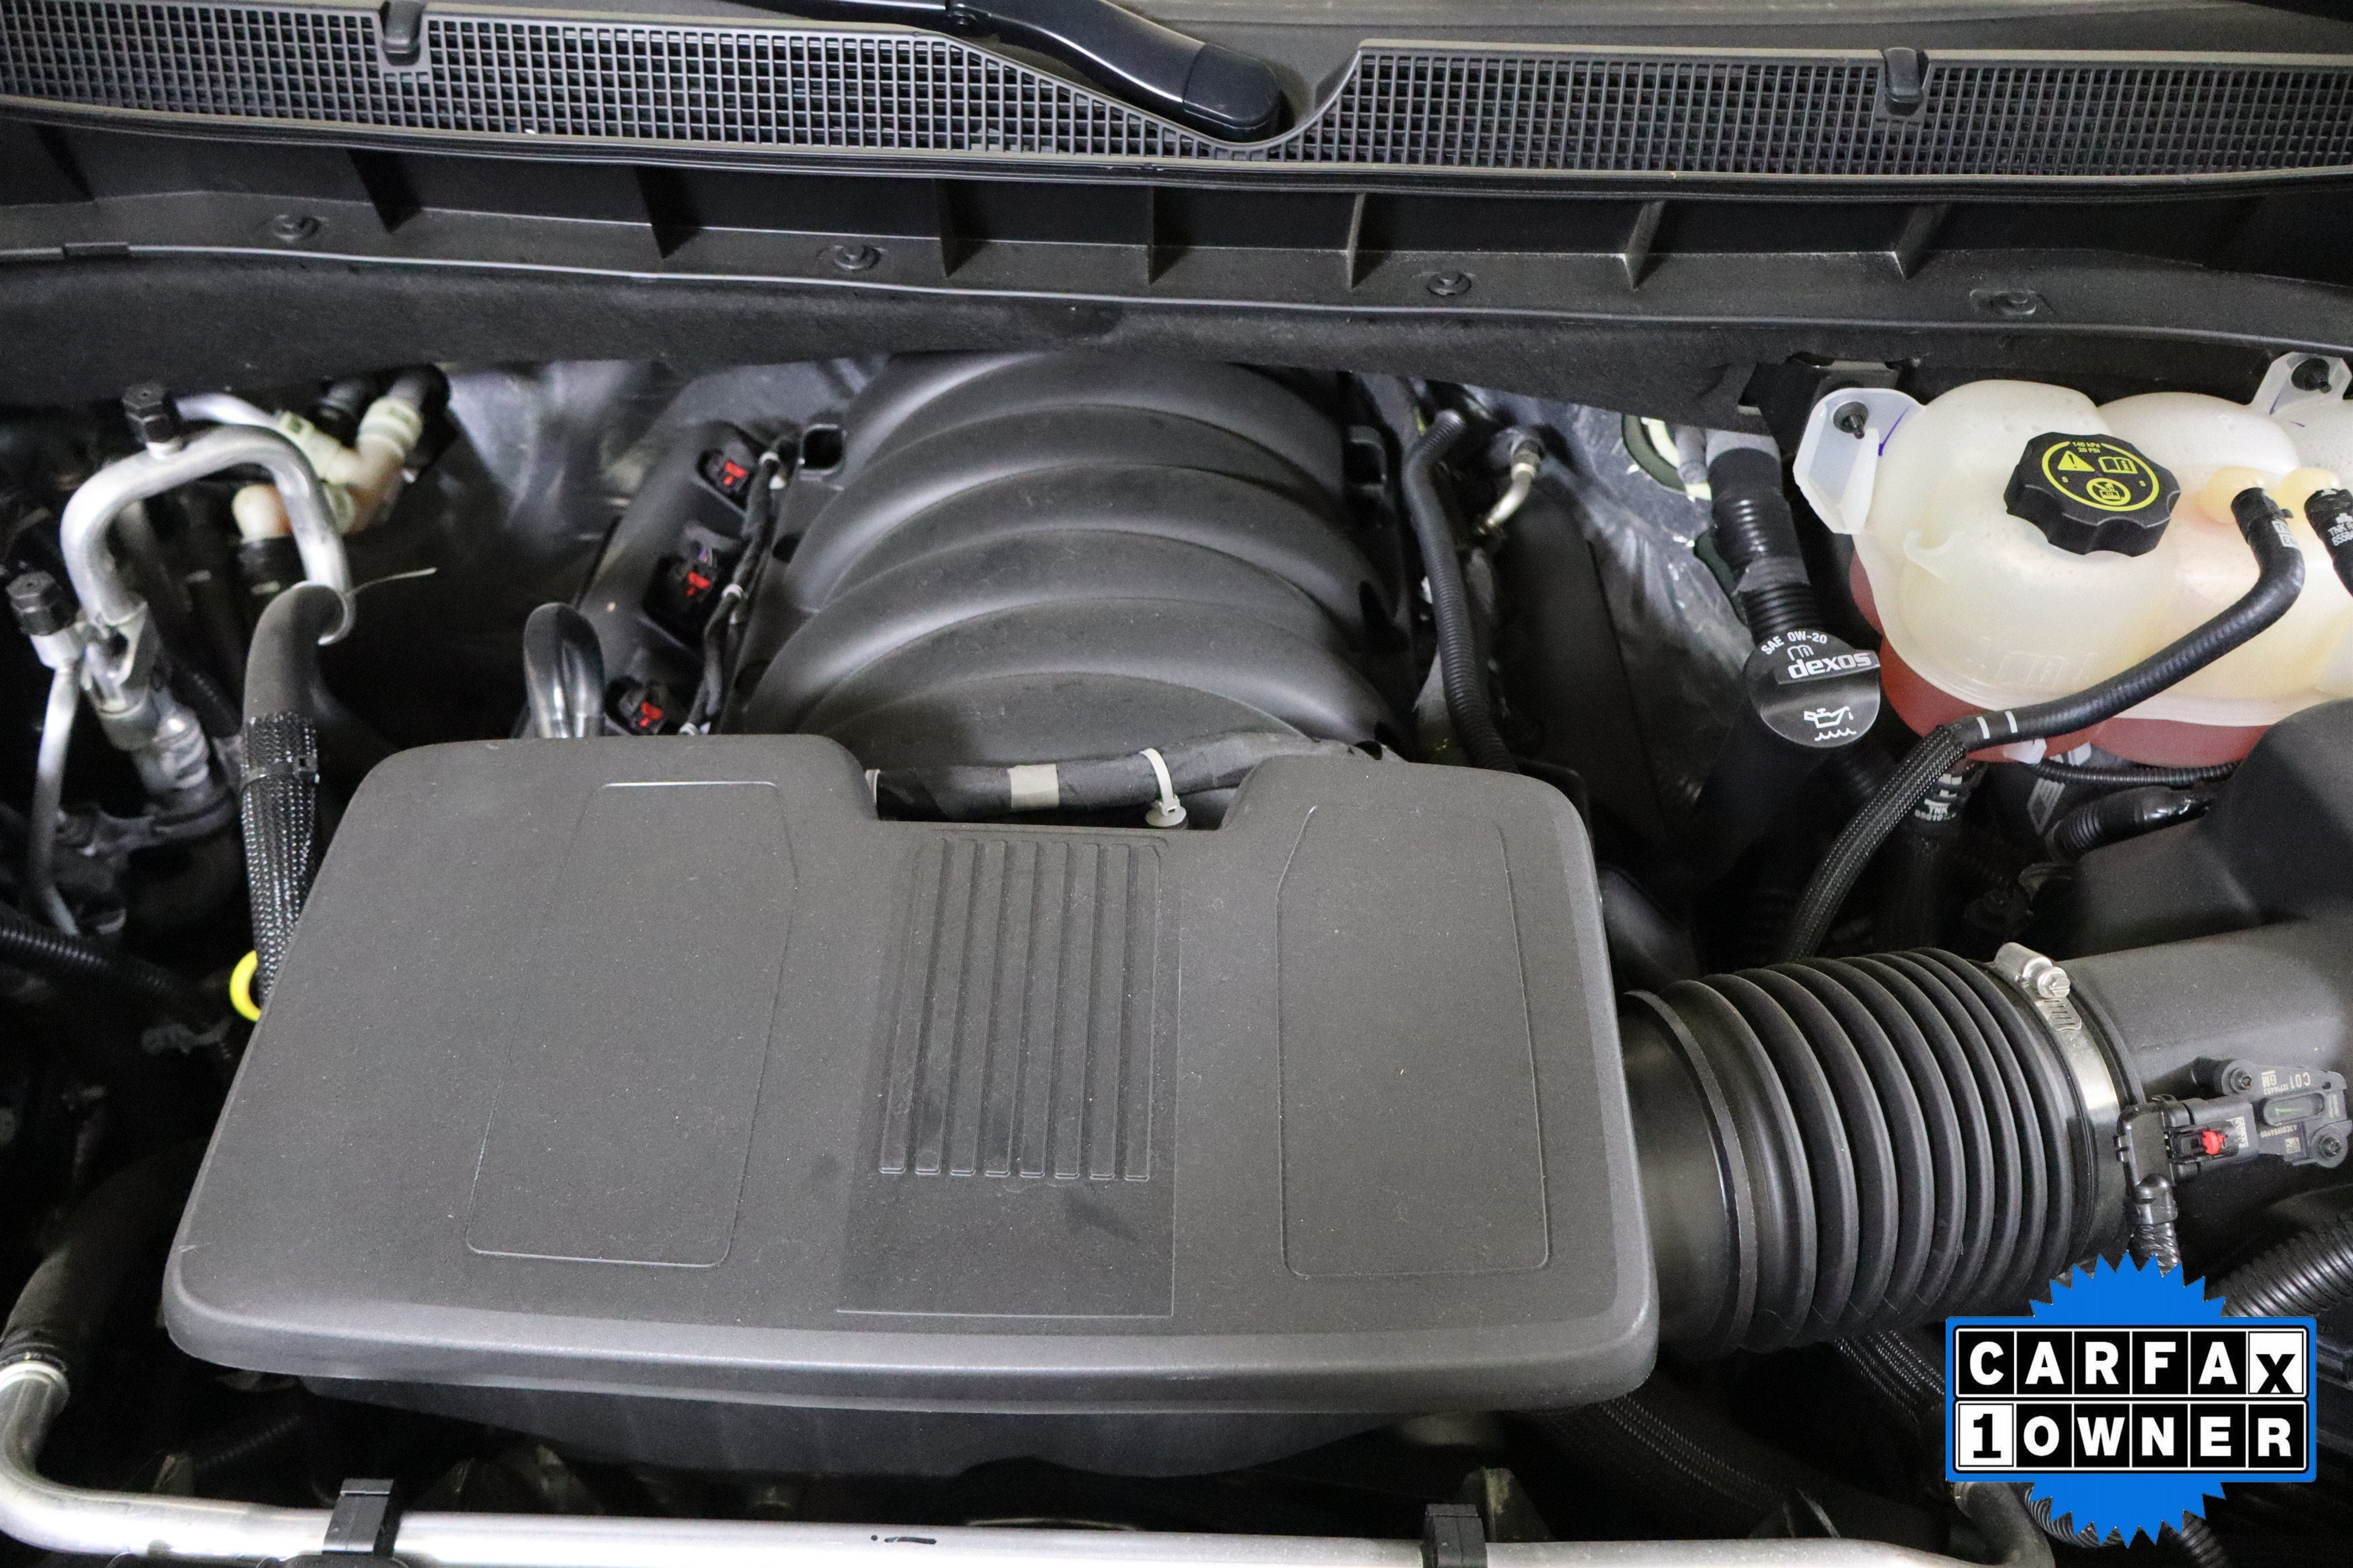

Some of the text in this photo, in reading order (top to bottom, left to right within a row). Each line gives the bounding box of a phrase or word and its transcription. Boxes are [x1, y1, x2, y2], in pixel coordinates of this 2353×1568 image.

[1761, 631, 1828, 655] SAE 0W-20
[1788, 652, 1872, 679] dexos
[2261, 1074, 2277, 1088] GM
